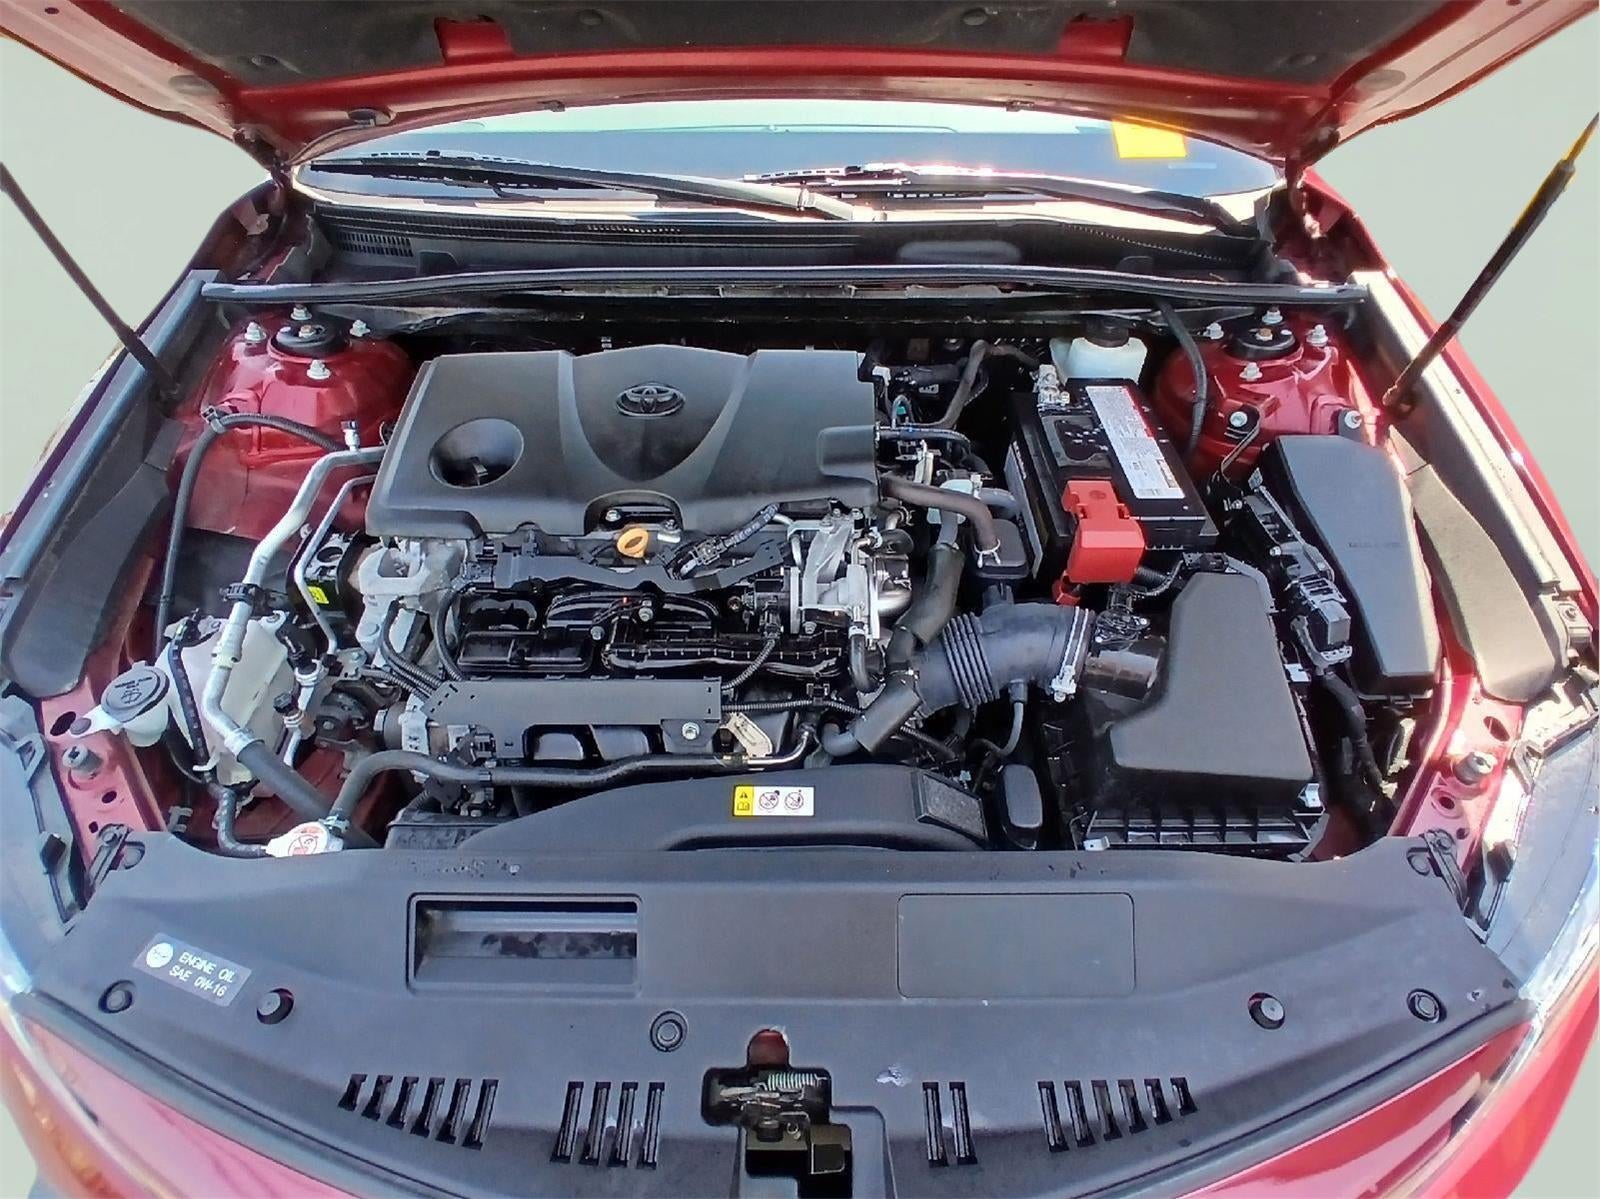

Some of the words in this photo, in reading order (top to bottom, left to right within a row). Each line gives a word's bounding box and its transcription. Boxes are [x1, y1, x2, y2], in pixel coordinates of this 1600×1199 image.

[169, 965, 193, 982] SAE
[178, 951, 217, 975] ENGINE
[218, 968, 236, 983] OIL
